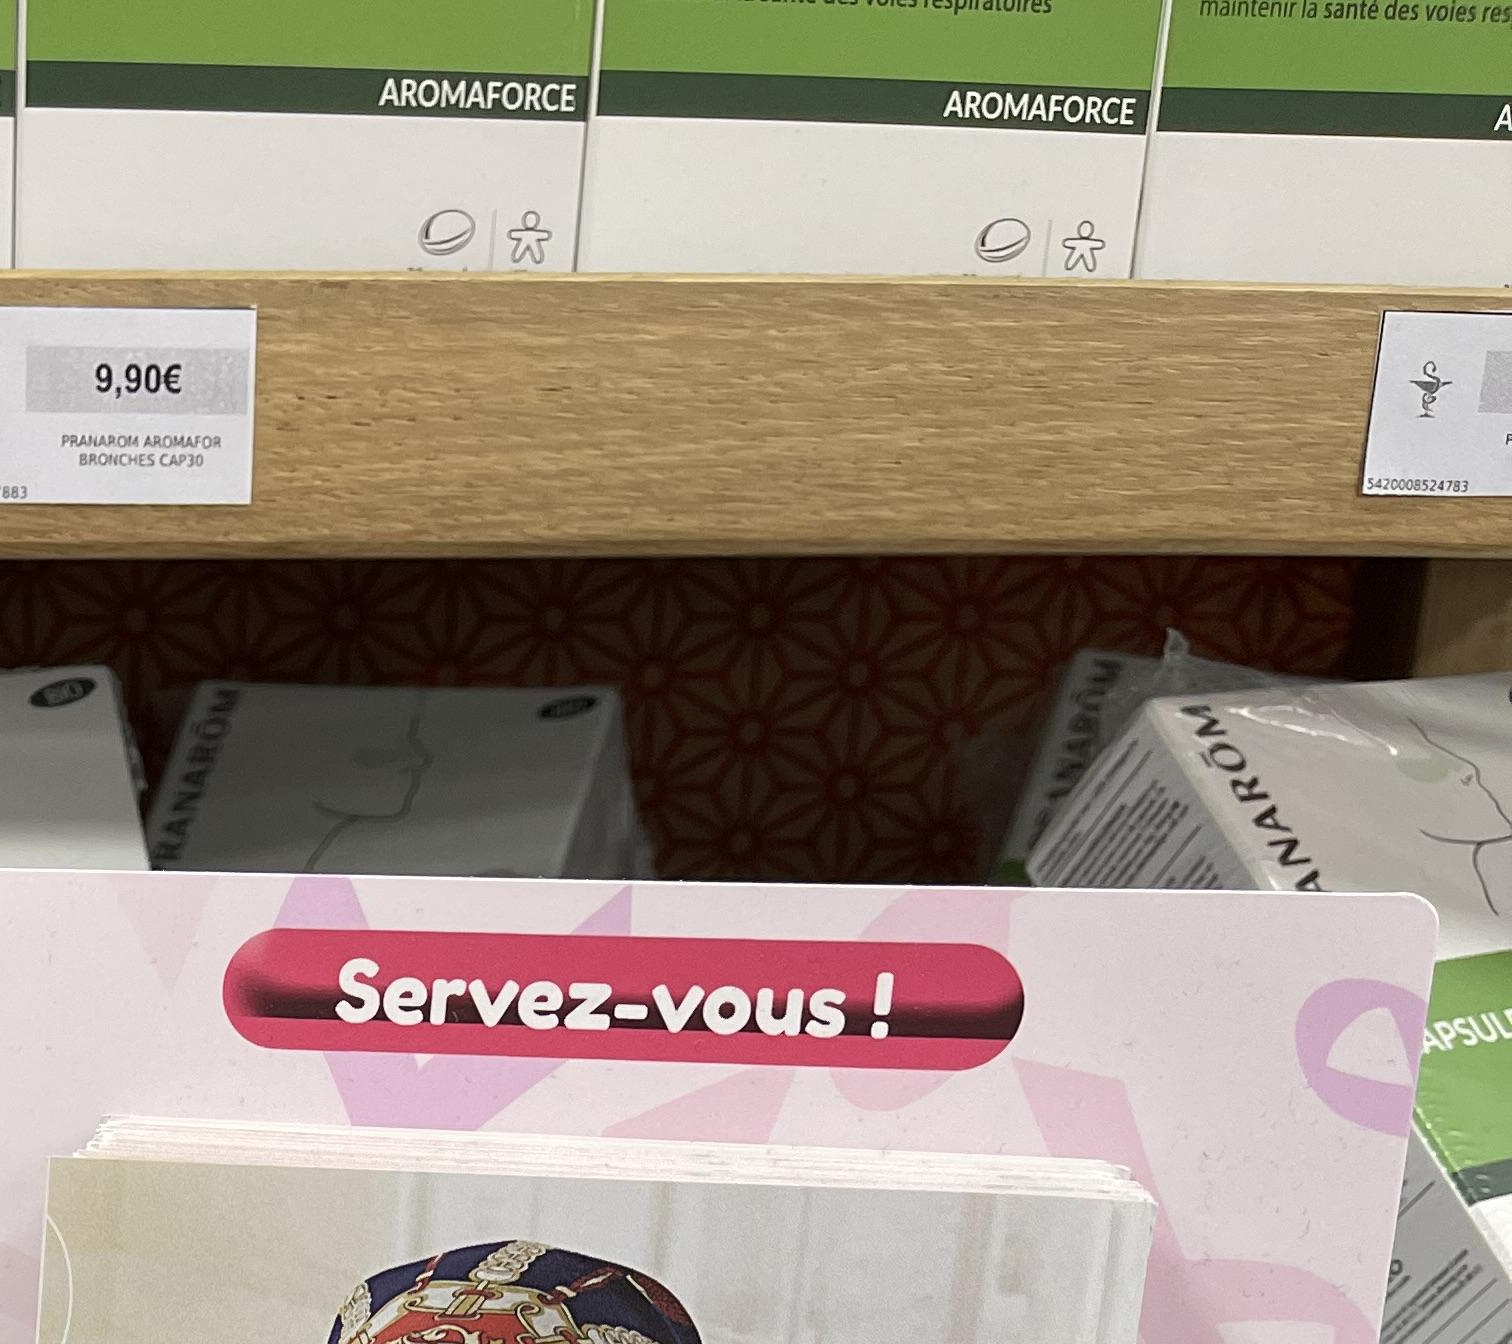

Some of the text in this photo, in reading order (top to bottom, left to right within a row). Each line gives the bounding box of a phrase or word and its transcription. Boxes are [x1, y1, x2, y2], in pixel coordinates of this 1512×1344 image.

[1323, 0, 1379, 21] santé
[1384, 0, 1419, 21] des
[1425, 2, 1477, 22] voies
[378, 77, 577, 113] AROMAFORCE
[943, 89, 1136, 127] AROMAFORCE
[95, 363, 182, 399] 9,90€
[60, 434, 222, 449] PRANAROM AROMAFOR
[79, 453, 204, 467] BRONCHES CAP30
[334, 957, 895, 1041] Servez-vous !
